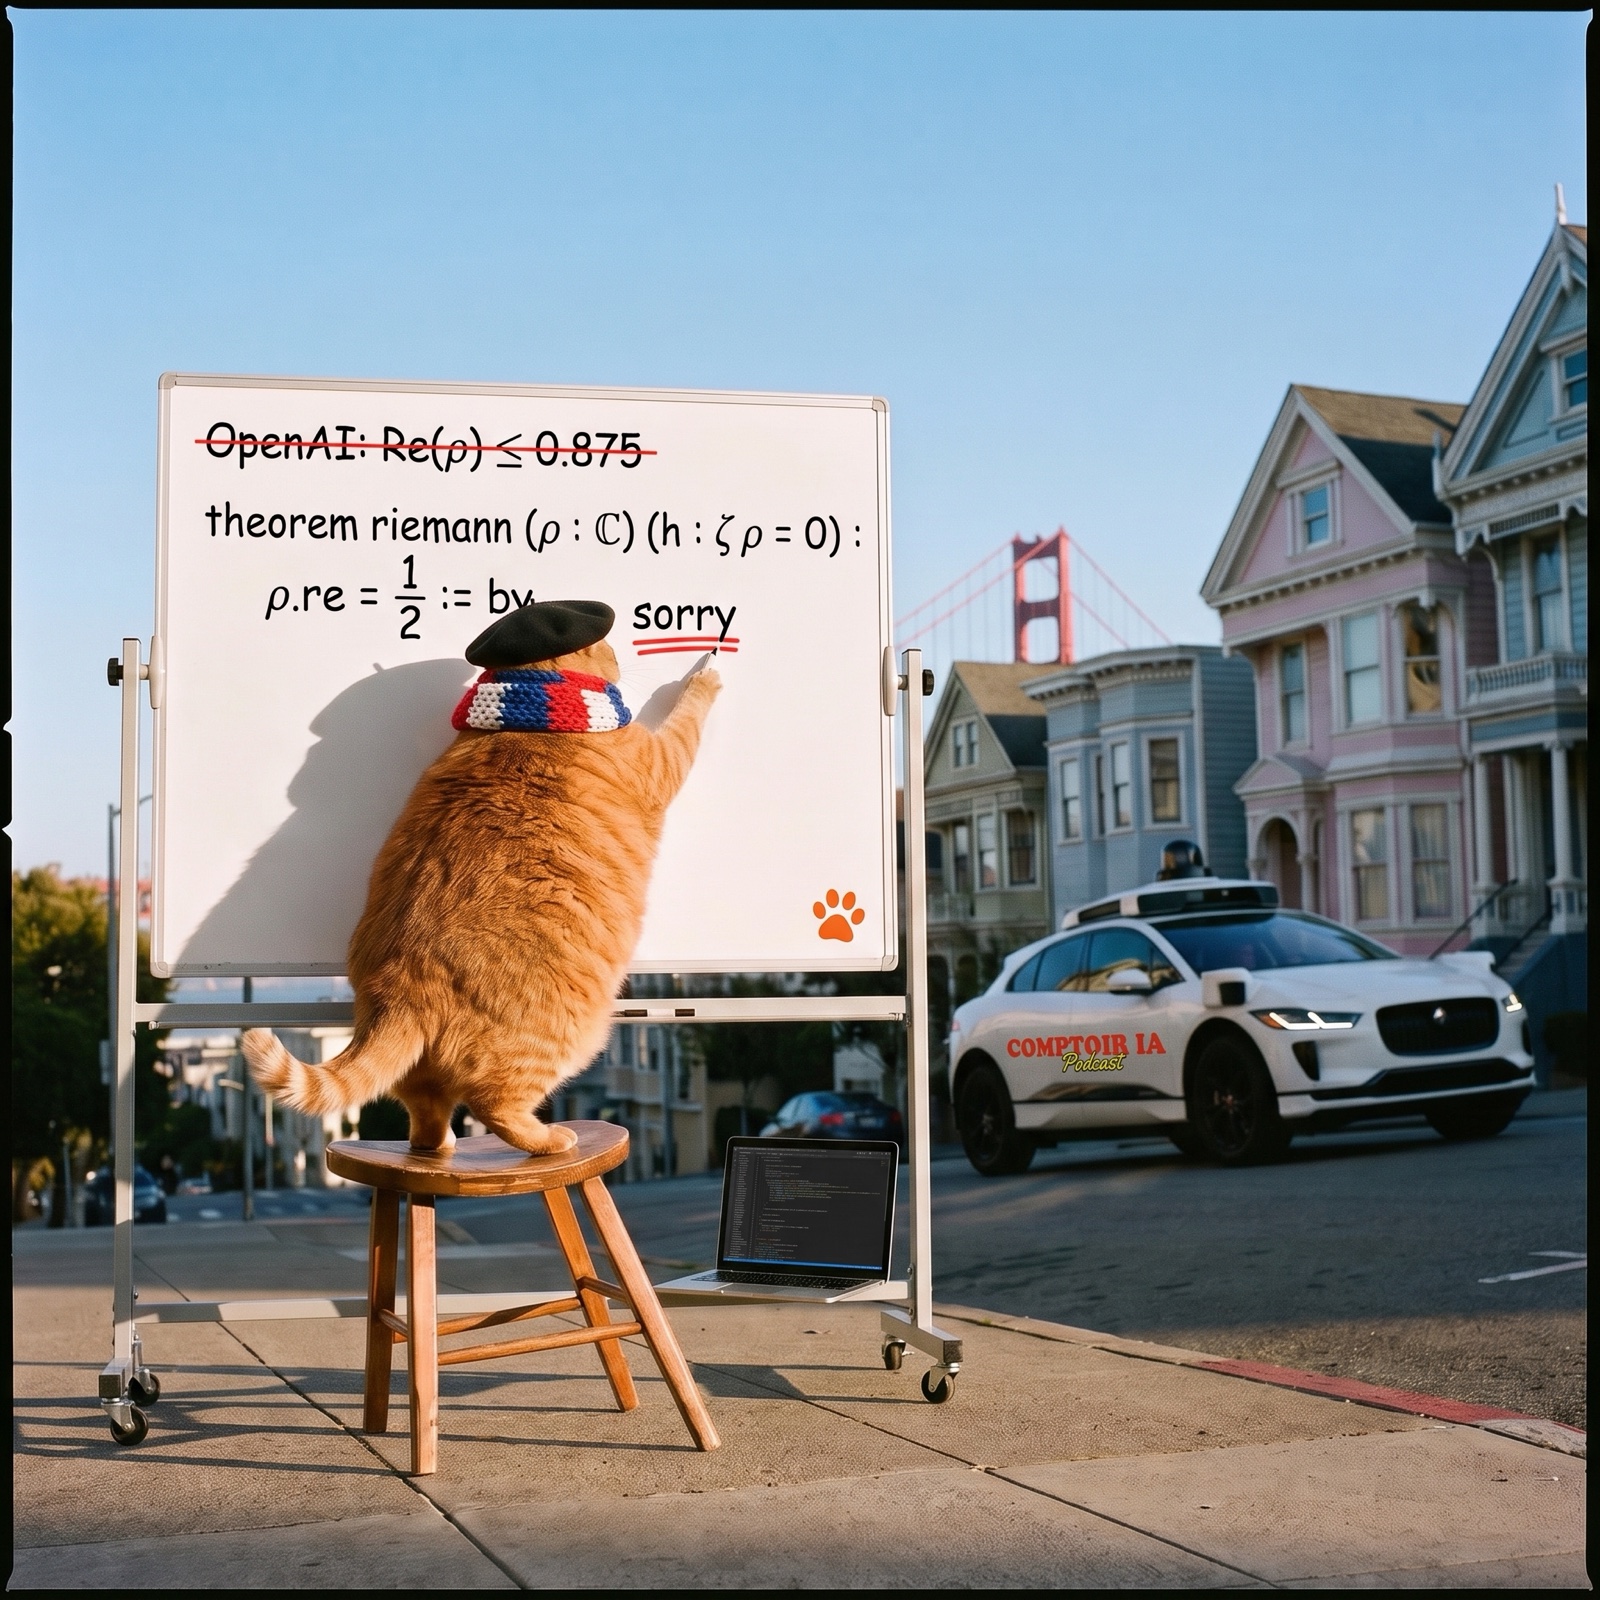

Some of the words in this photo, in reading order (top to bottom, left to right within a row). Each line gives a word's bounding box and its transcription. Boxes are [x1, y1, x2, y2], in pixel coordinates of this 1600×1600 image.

[206, 421, 366, 470] OpenAI:
[535, 430, 642, 469] 0.875
[205, 500, 359, 543] theorem
[372, 507, 512, 544] riemann
[647, 510, 681, 555] (h
[775, 526, 792, 543] =
[804, 515, 841, 558] 0)
[359, 587, 379, 605] =
[442, 586, 472, 610] :=
[632, 602, 737, 643] sorry
[1006, 1033, 1130, 1058] COMPTOIR
[1135, 1031, 1167, 1055] IA
[1061, 1051, 1127, 1073] Podcast
